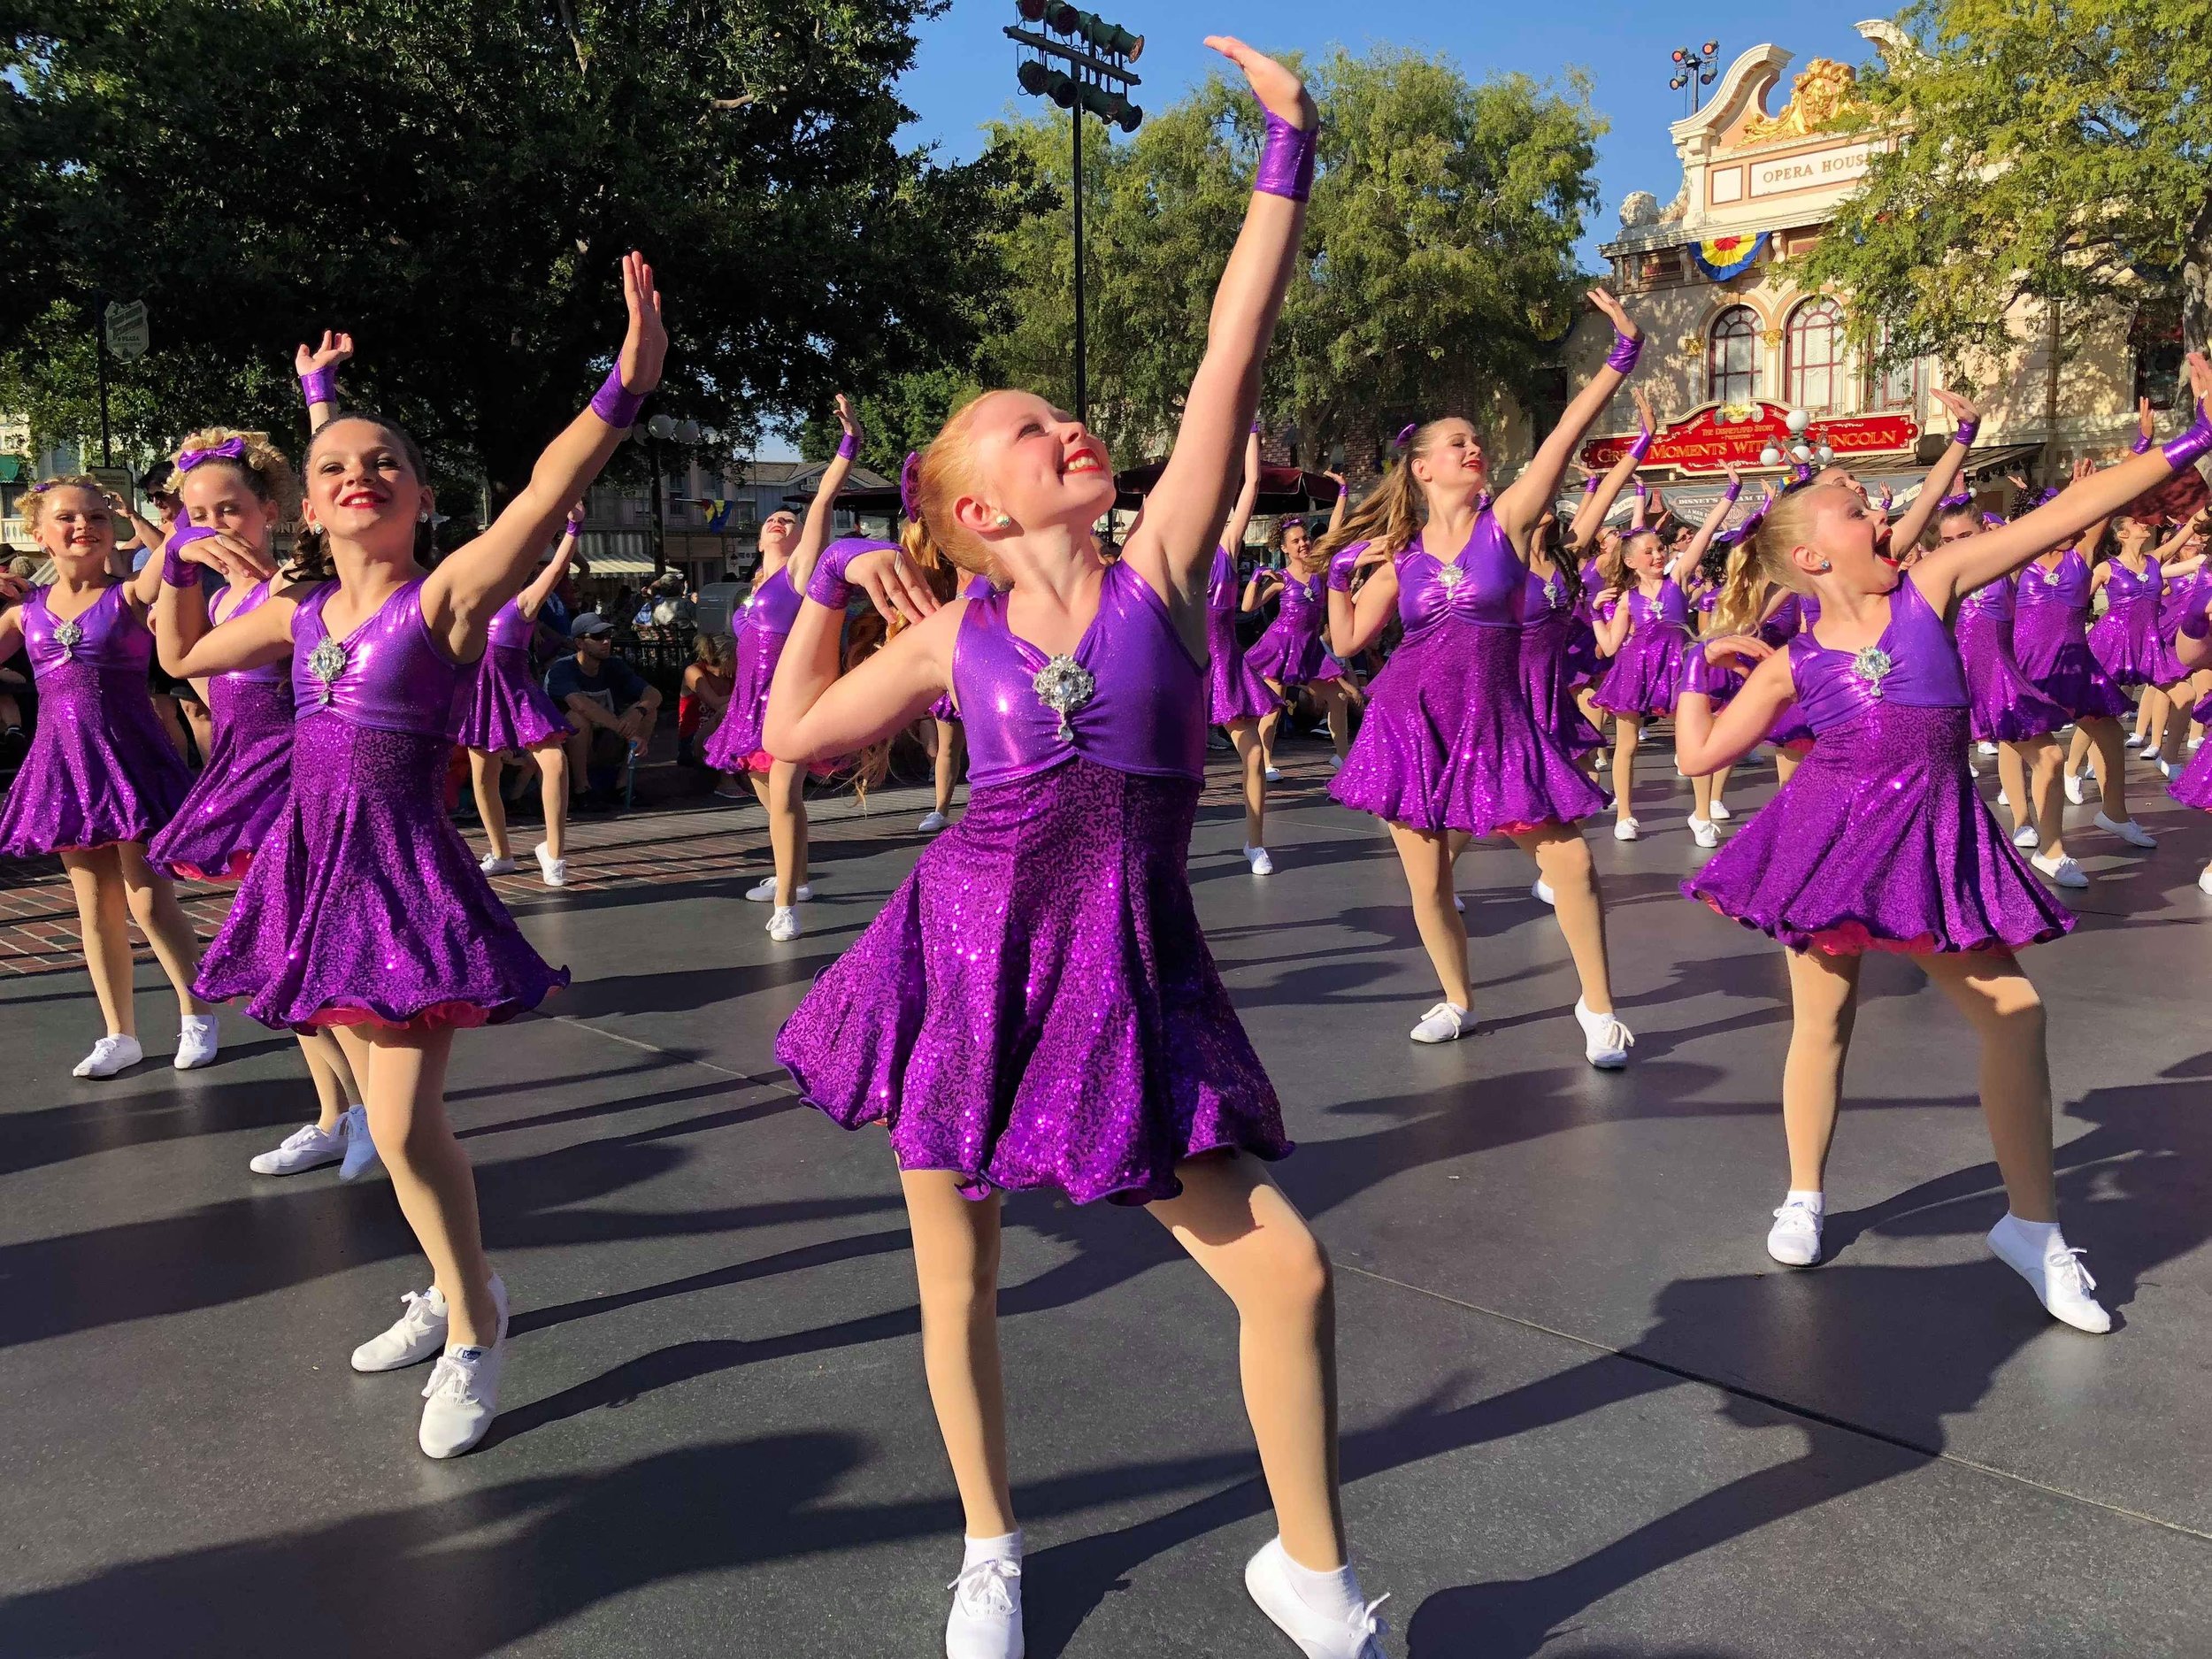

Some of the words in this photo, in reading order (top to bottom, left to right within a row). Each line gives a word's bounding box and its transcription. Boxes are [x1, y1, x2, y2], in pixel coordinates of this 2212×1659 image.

[1763, 164, 1813, 183] OPERA
[1716, 426, 1754, 435] DISNEYLAND
[1597, 449, 1629, 463] GRE
[1649, 442, 1727, 460] MOMENTS
[1732, 439, 1768, 455] WIT
